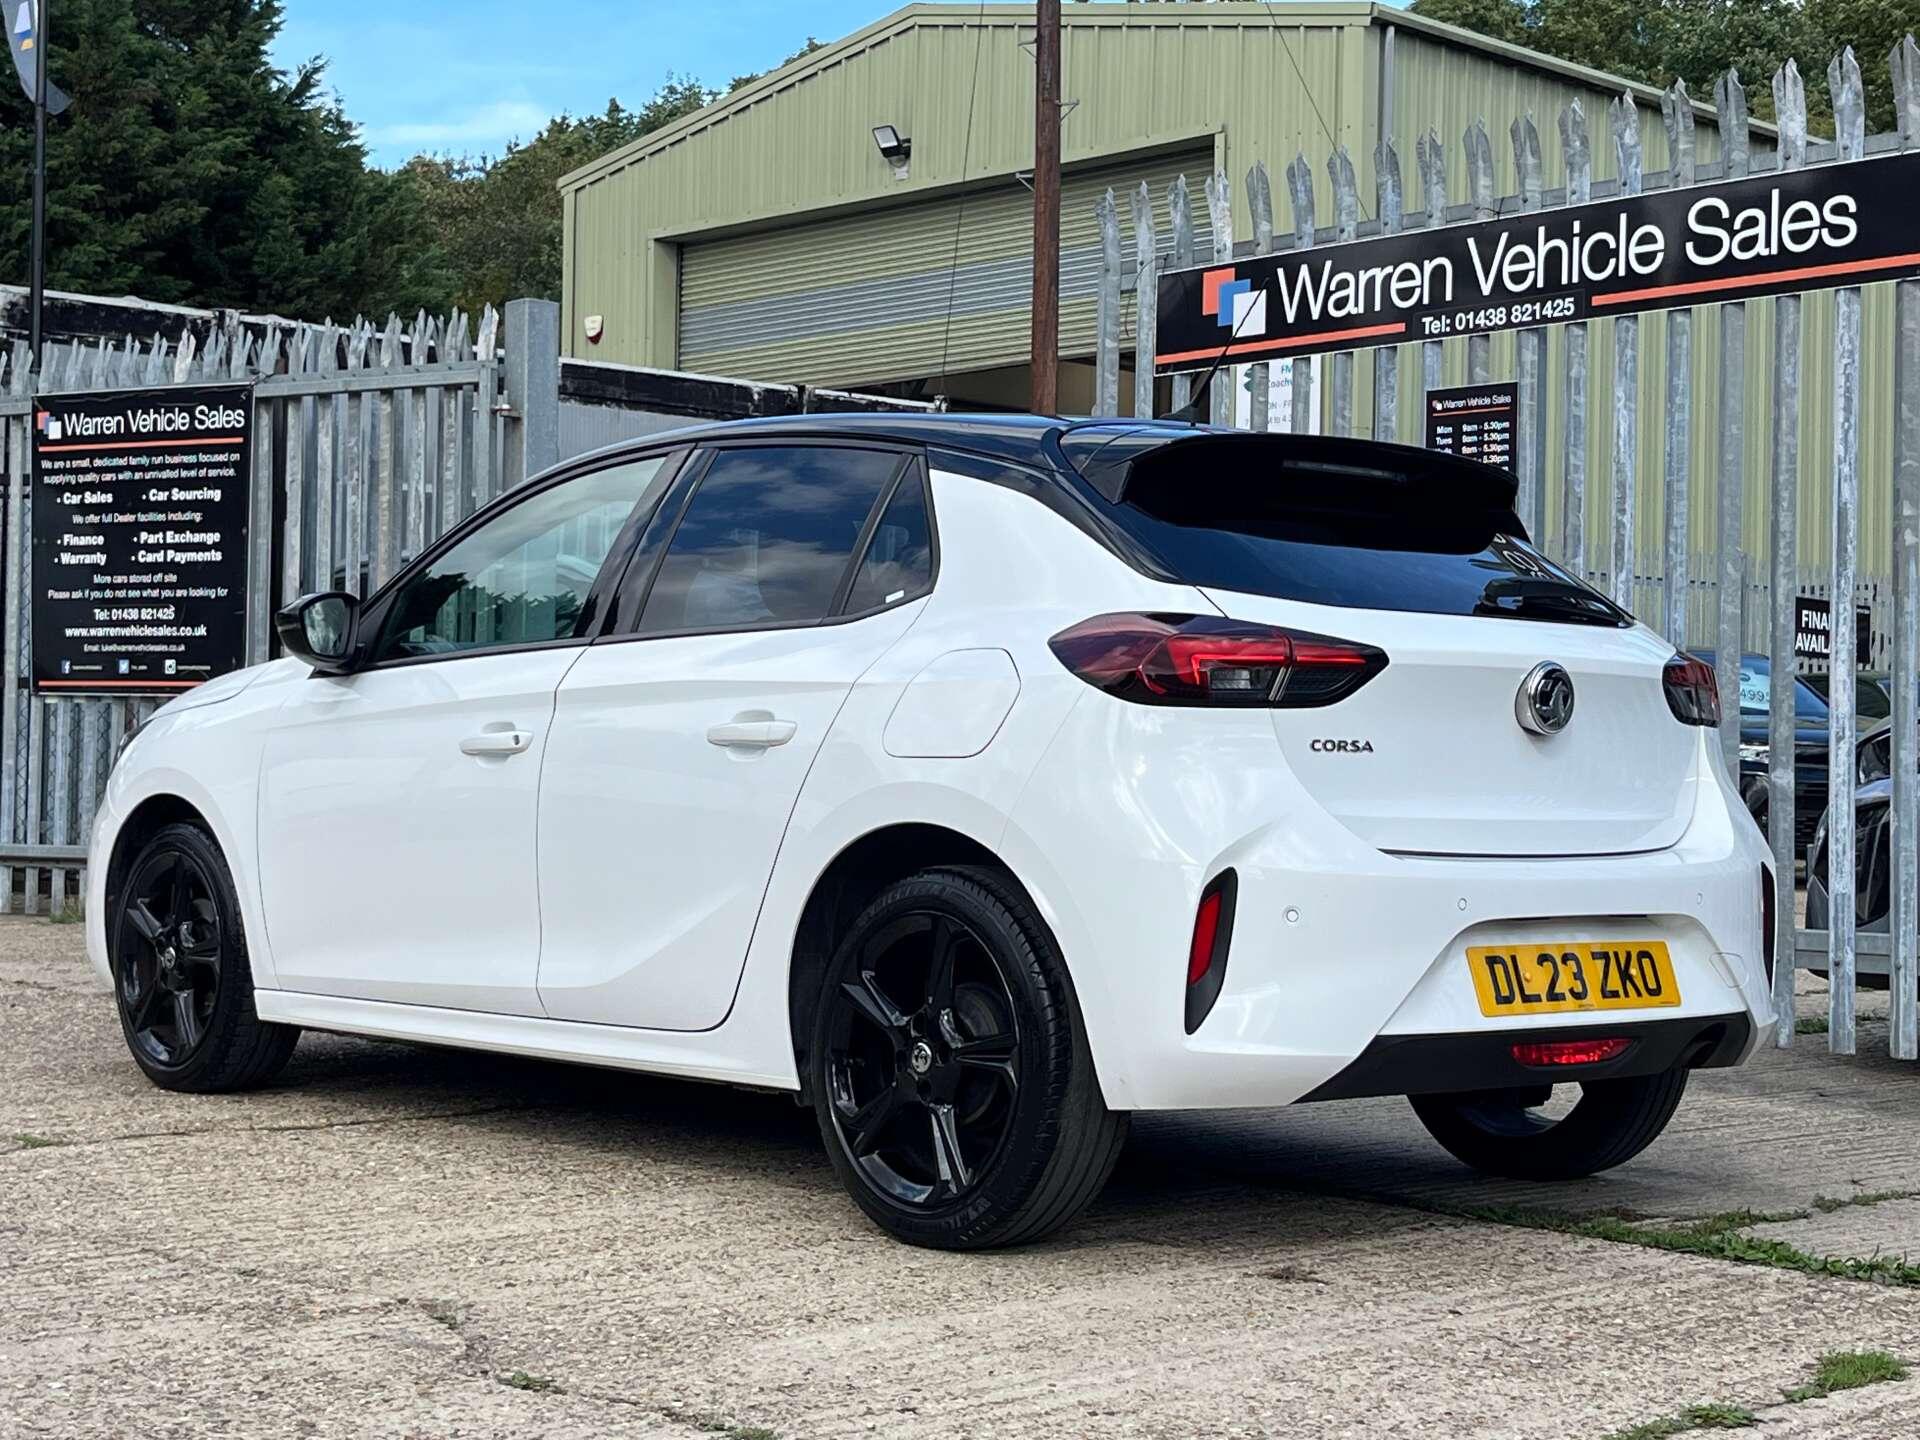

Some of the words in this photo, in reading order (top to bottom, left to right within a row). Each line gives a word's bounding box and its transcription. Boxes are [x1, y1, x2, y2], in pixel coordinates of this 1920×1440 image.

[1277, 256, 1453, 324] Warren
[1467, 213, 1665, 297] Vehicle
[1685, 188, 1858, 266] Sales
[1422, 317, 1450, 335] Tel:
[1455, 309, 1507, 331] 01438
[1510, 298, 1575, 323] 821425
[1442, 399, 1466, 409] Warren
[1467, 396, 1491, 407] Vehicle
[1492, 394, 1512, 405] Sales
[64, 411, 124, 437] Warren
[127, 406, 190, 434] Vehicle
[194, 404, 245, 430] Sales
[1436, 426, 1453, 434] Mon
[1483, 421, 1510, 431] 5.30pm
[1436, 437, 1453, 445] Tues
[1483, 432, 1510, 442] 5.30pm
[41, 459, 52, 469] We
[54, 461, 65, 469] are
[93, 456, 128, 467] dedicated
[129, 455, 150, 468] family
[151, 456, 163, 464] run
[165, 454, 197, 463] business
[199, 452, 228, 463] focused
[230, 453, 240, 461] on
[43, 473, 76, 485] supplying
[77, 472, 100, 484] quality
[101, 473, 116, 481] cars
[118, 471, 133, 480] with
[180, 468, 198, 477] level
[198, 467, 206, 477] of
[207, 466, 236, 477] service.
[63, 492, 82, 504] Car
[84, 491, 113, 504] Sales
[149, 488, 169, 501] Car
[171, 487, 221, 502] Sourcing
[72, 514, 84, 524] We
[85, 513, 100, 523] offer
[102, 513, 112, 523] full
[113, 513, 136, 523] Dealer
[137, 512, 166, 522] facilities
[168, 510, 203, 523] including:
[63, 533, 105, 546] Finance
[140, 531, 163, 544] Part
[166, 530, 221, 545] Exchange
[60, 552, 107, 566] Warranty
[138, 549, 164, 563] Card
[166, 548, 222, 564] Payments
[93, 573, 111, 584] More
[112, 575, 128, 583] cars
[129, 573, 152, 583] stored
[153, 573, 163, 583] off
[164, 573, 177, 583] site
[48, 589, 70, 599] Please
[71, 589, 83, 599] ask
[84, 589, 89, 598] if
[90, 591, 103, 600] you
[104, 589, 113, 598] do
[115, 589, 127, 598] not
[128, 590, 140, 598] see
[142, 588, 159, 598] what
[160, 590, 175, 599] you
[175, 589, 187, 597] are
[189, 587, 216, 599] looking
[217, 587, 228, 597] for
[93, 608, 110, 620] Tel:
[111, 608, 139, 620] 01438
[141, 607, 175, 620] 821425
[65, 624, 207, 637] www.warrenvehiclesales.co.uk
[1795, 632, 1830, 653] AVAIL
[1310, 739, 1374, 752] CORSA
[1485, 952, 1588, 1005] DL23
[1590, 950, 1662, 998] ZKO
